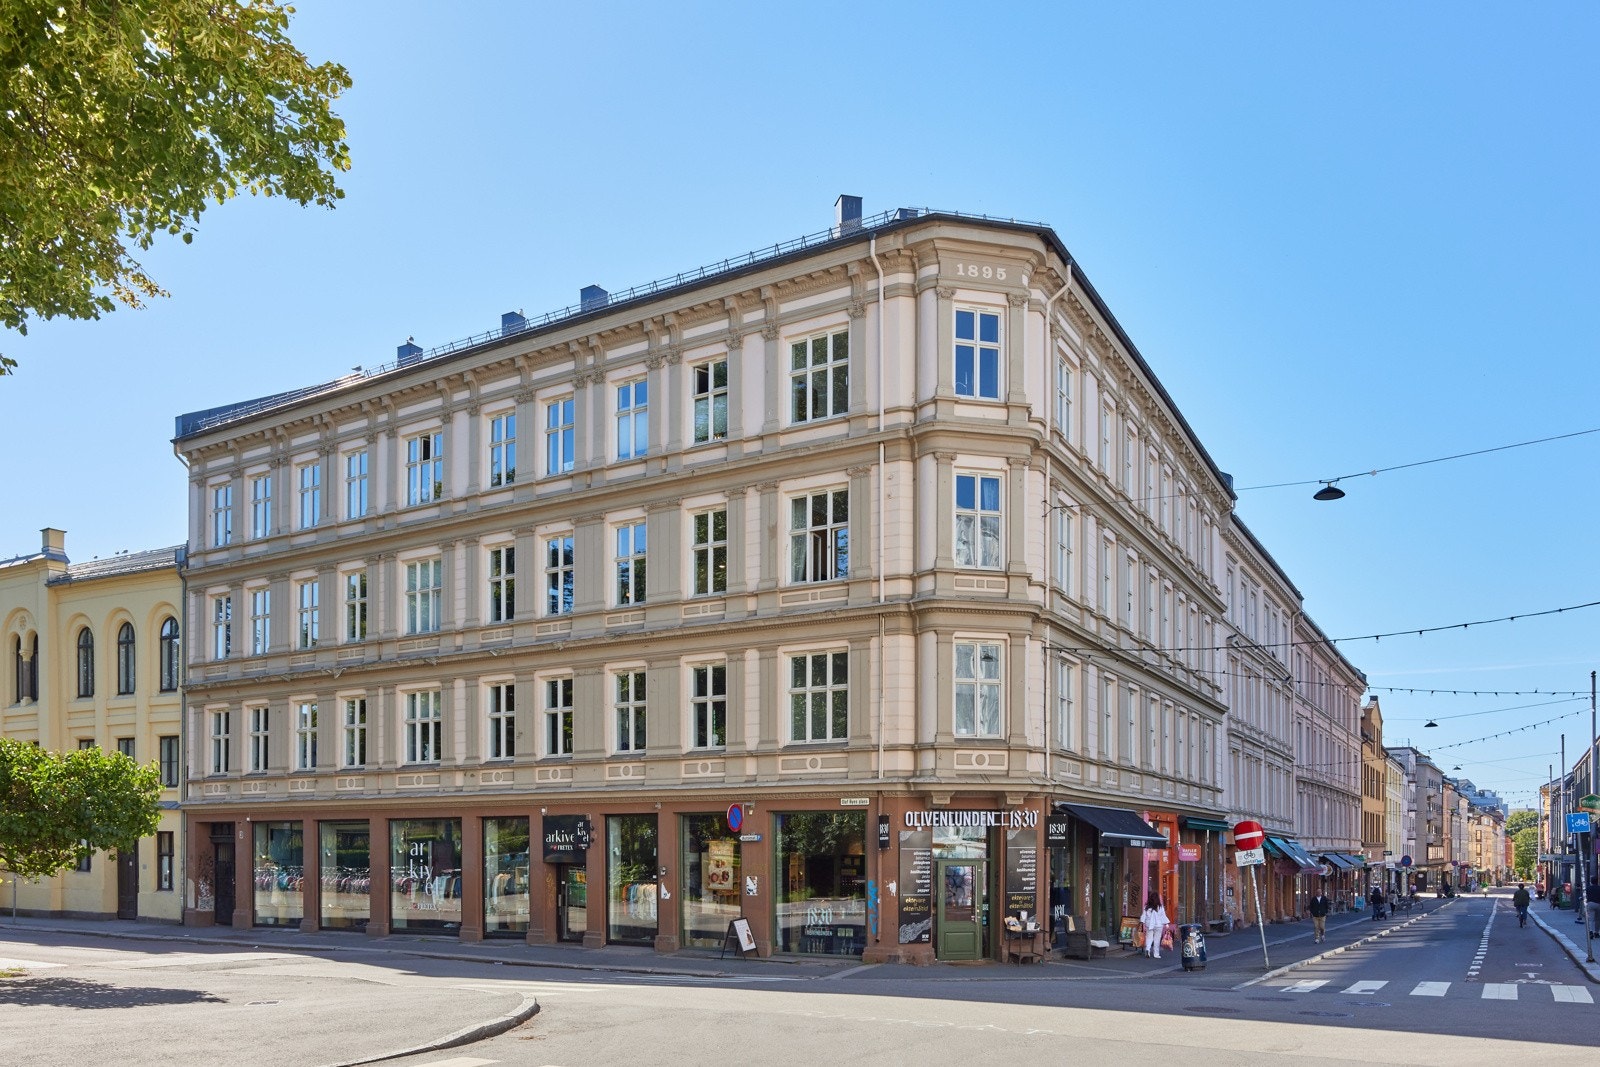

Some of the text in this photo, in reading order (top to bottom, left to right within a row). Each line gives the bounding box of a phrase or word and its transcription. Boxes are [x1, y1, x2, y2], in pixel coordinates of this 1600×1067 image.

[956, 263, 1007, 280] 1895
[905, 810, 1040, 828] OLIVENLUNDEN 1830
[1049, 823, 1066, 834] 1830
[546, 830, 574, 842] arkive
[410, 842, 426, 856] ar
